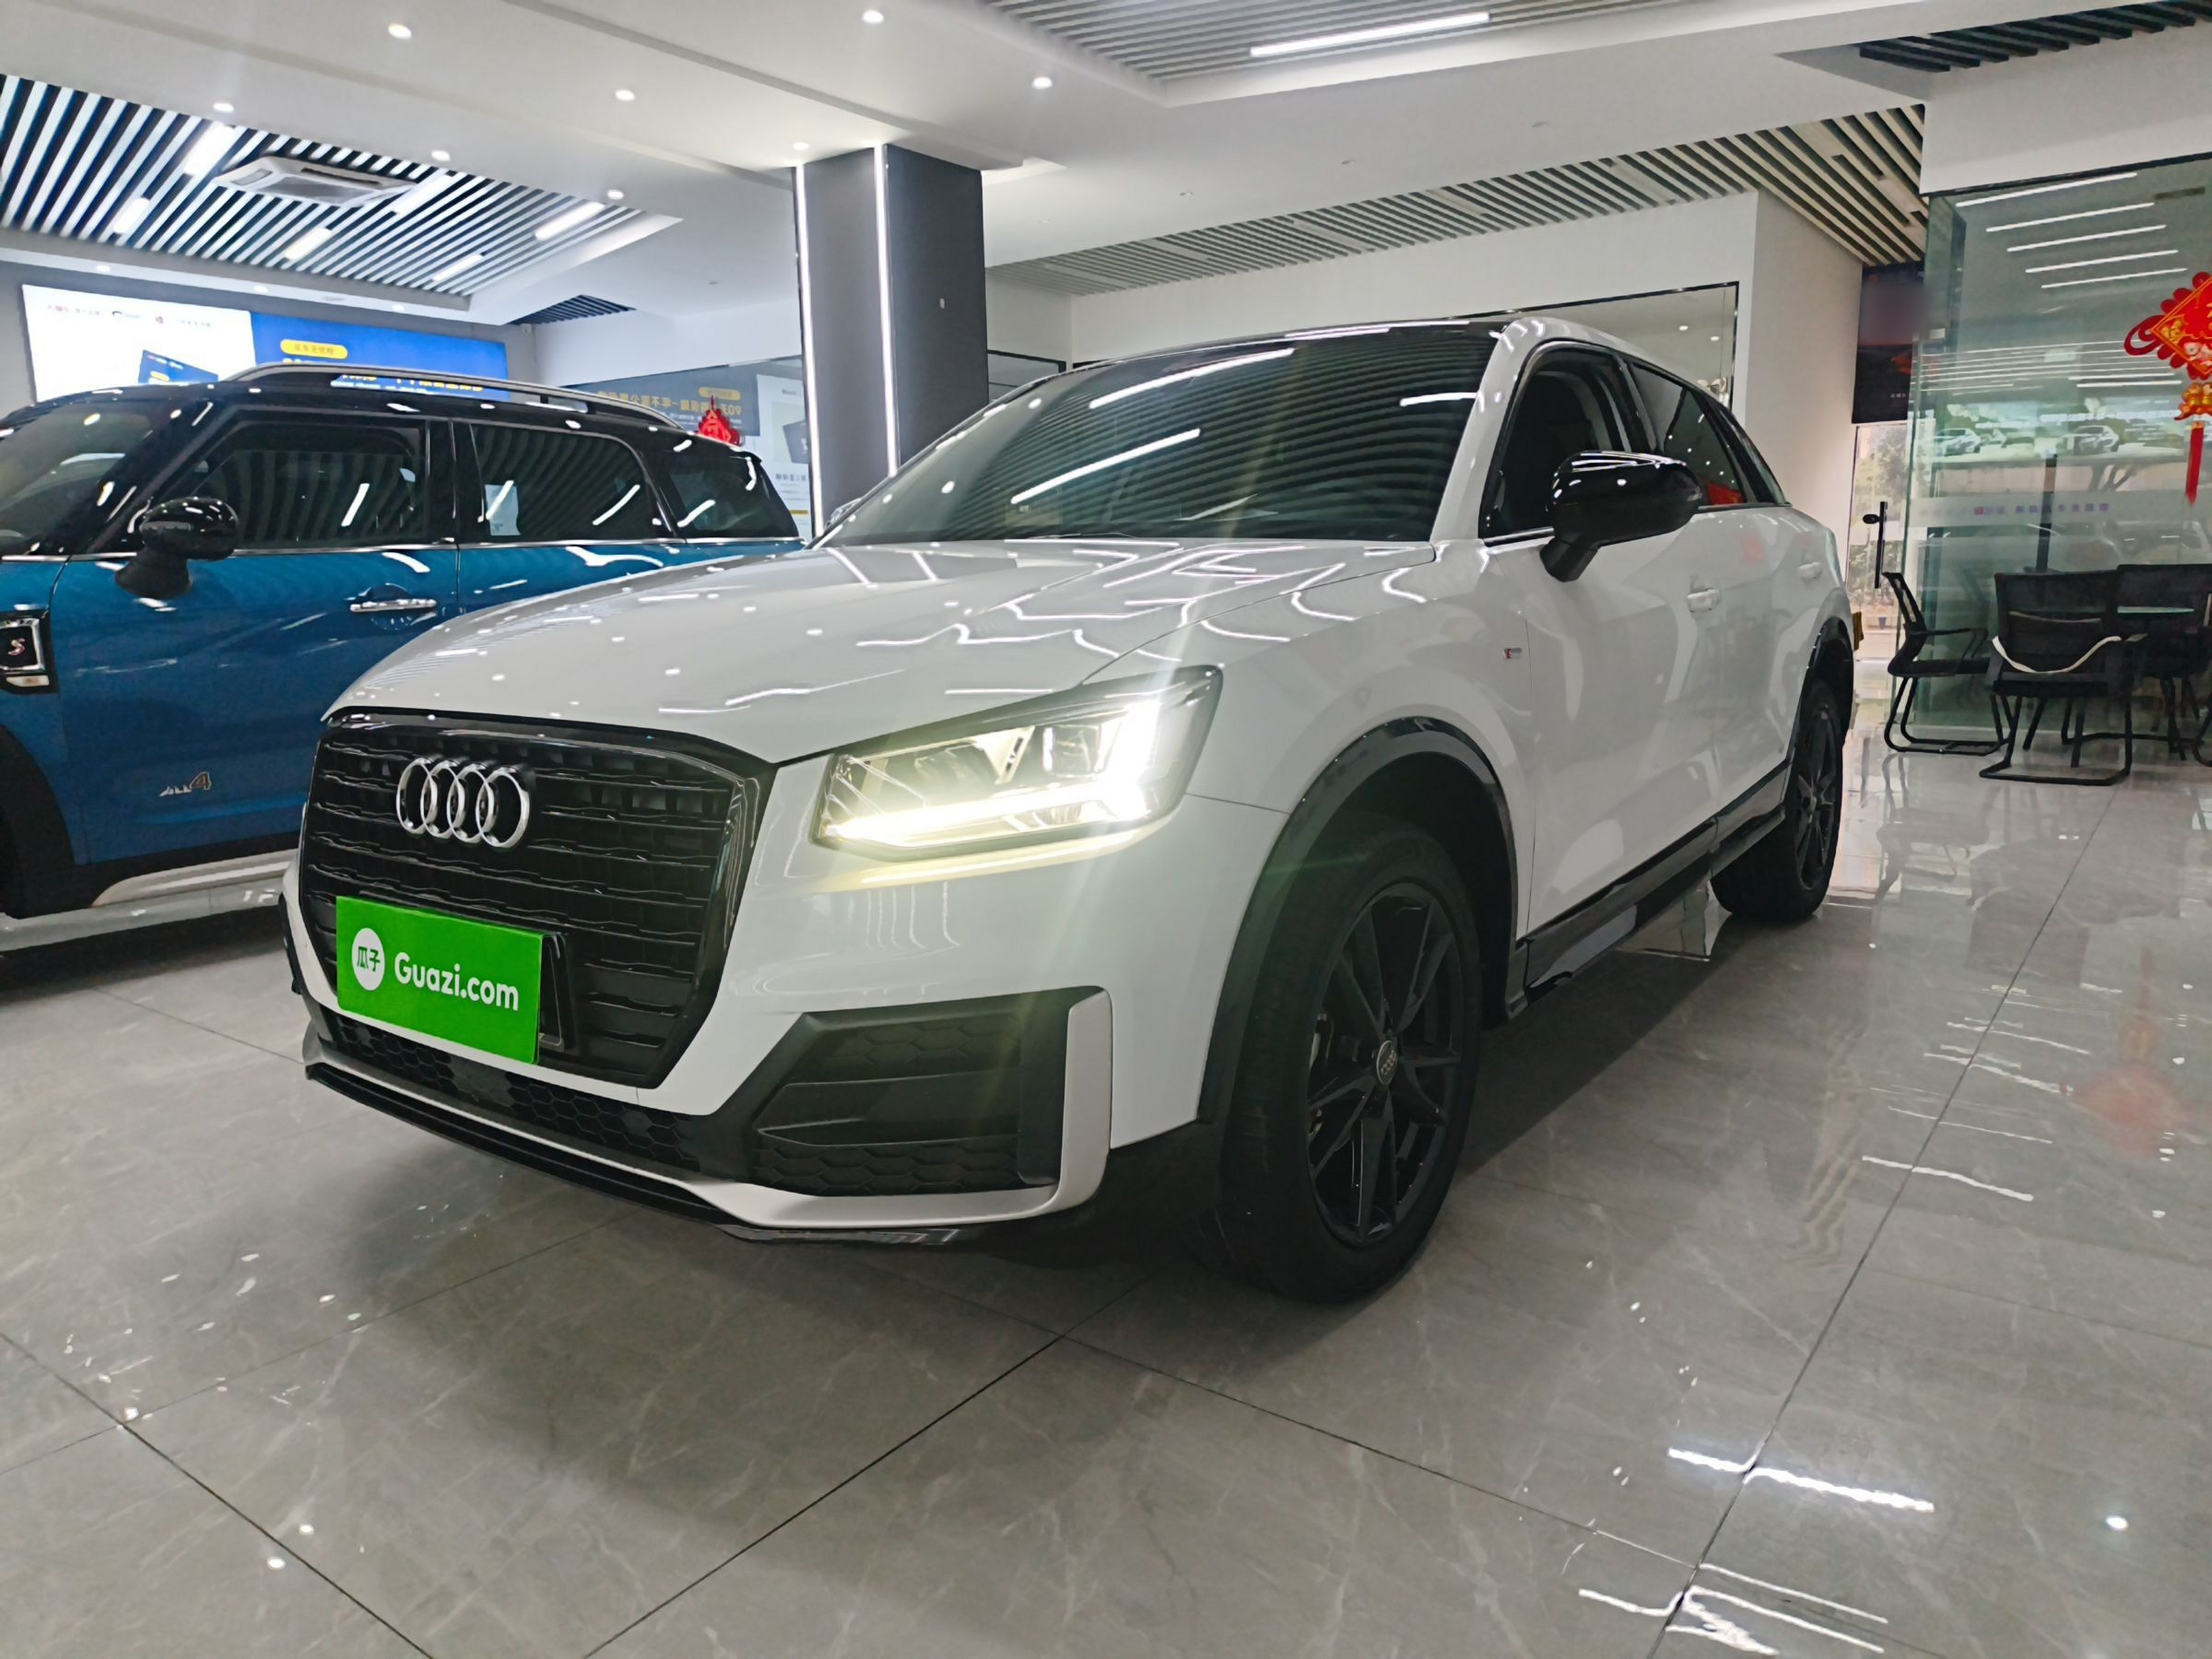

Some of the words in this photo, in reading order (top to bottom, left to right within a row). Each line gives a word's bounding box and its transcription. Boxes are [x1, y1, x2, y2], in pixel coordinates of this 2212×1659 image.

[8, 638, 25, 656] S
[357, 946, 381, 972] 瓜子
[394, 952, 519, 1011] Guazi.com
